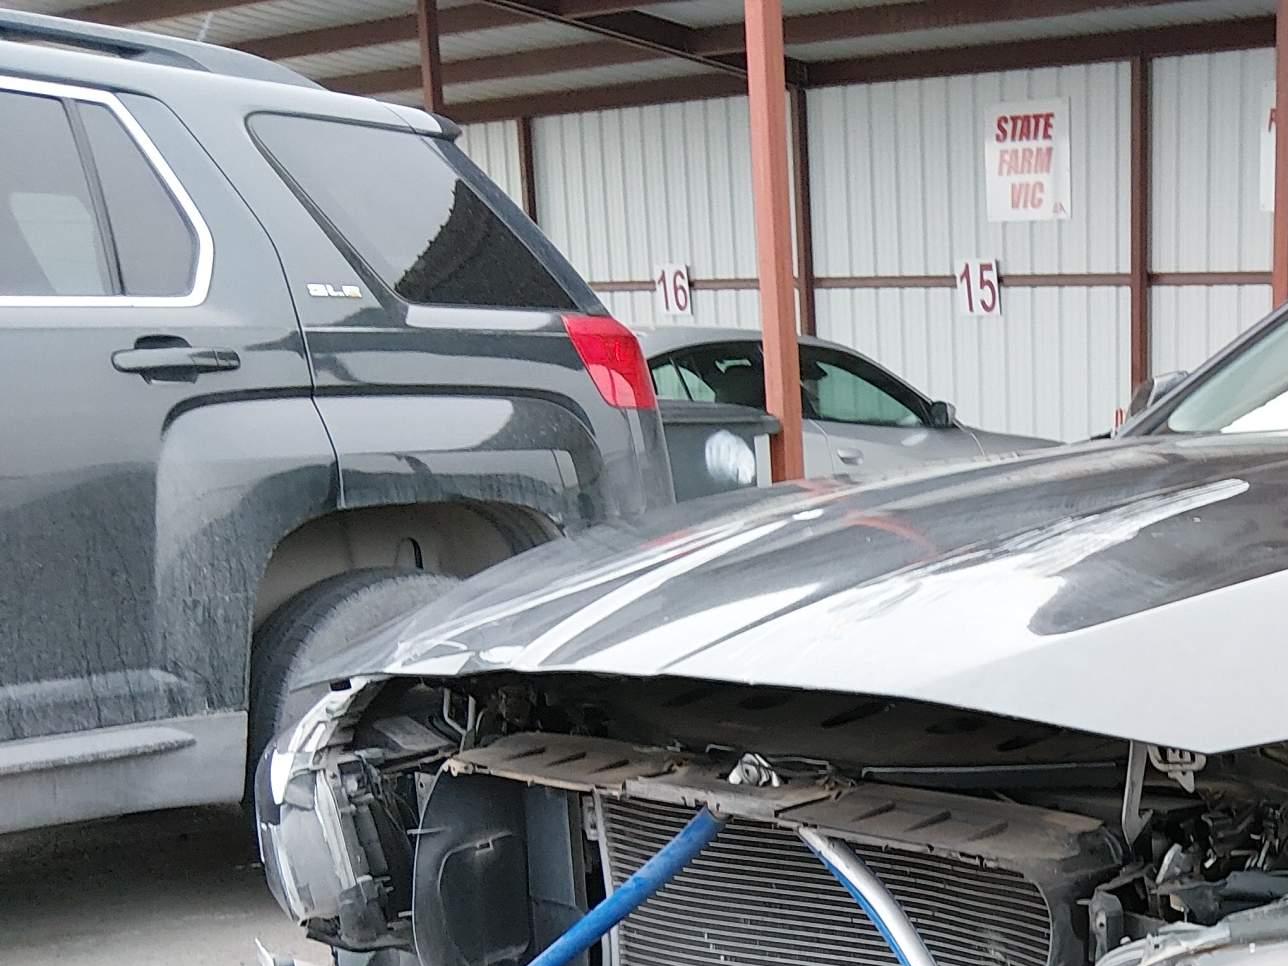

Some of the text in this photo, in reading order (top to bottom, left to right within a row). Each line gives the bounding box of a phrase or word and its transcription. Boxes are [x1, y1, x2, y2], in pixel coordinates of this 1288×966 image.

[995, 112, 1055, 143] STATE
[998, 147, 1053, 176] FARM
[1011, 182, 1045, 209] VIC
[657, 269, 688, 311] 16
[960, 262, 996, 313] 15
